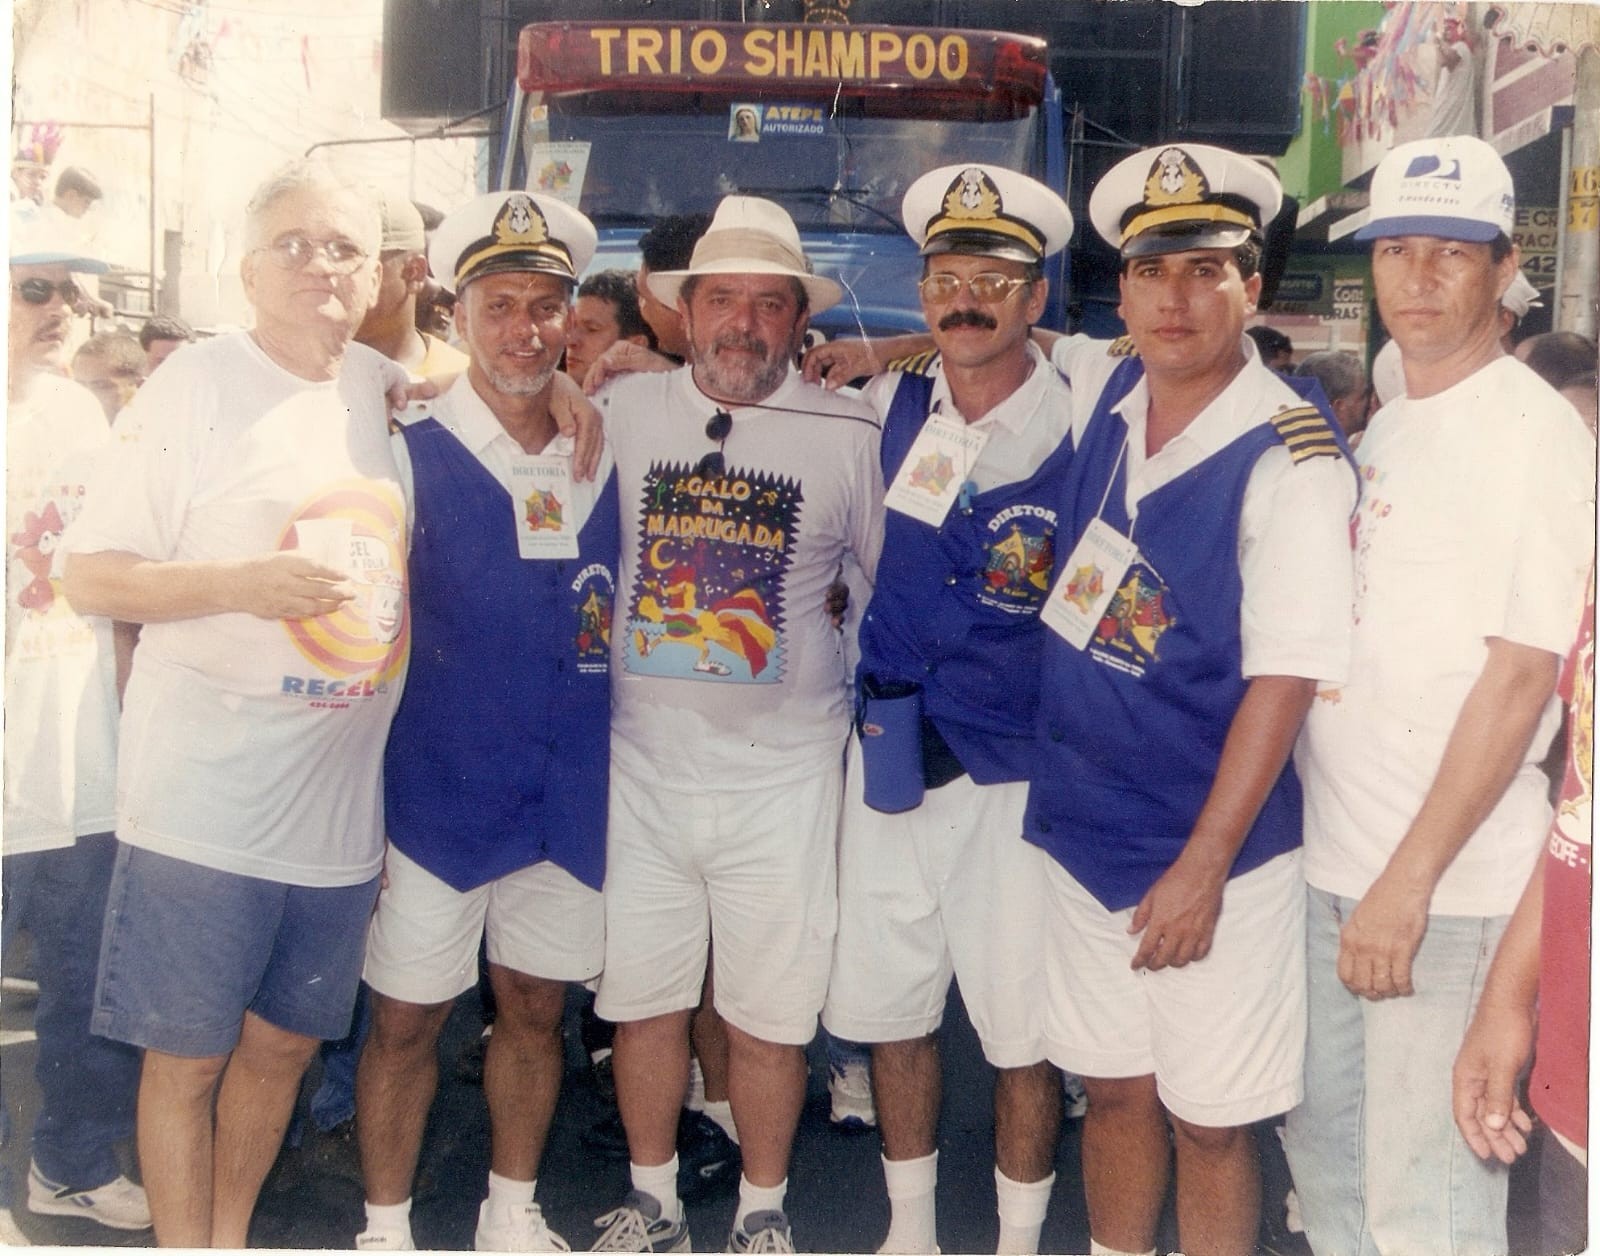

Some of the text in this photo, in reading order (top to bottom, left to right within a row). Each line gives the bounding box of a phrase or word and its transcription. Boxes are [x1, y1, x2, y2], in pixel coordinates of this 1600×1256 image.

[591, 28, 968, 81] TRIO SHAMPOO
[766, 106, 822, 121] ATEPE
[763, 123, 824, 133] AUTORIZADO
[512, 464, 566, 477] DIRETORIA
[687, 476, 751, 501] GALO
[702, 500, 724, 514] DA
[647, 514, 785, 552] MADRUGADA
[281, 675, 376, 697] RECEL
